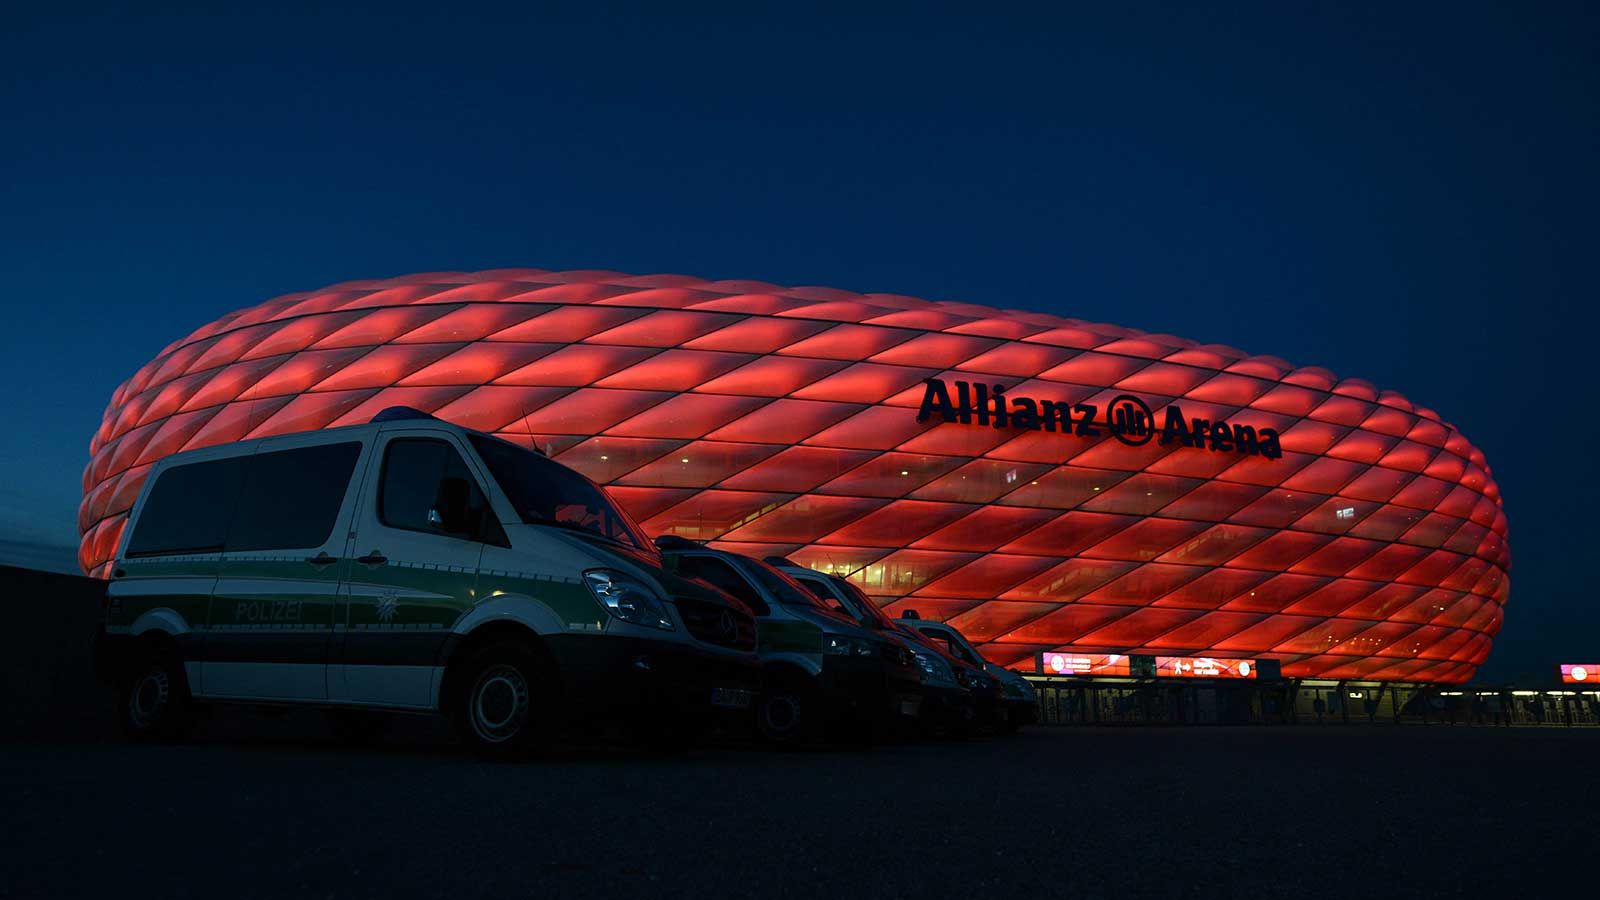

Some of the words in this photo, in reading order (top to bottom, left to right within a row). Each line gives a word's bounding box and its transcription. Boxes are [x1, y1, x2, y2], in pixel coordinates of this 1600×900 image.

[916, 378, 1100, 437] Allianz
[1158, 405, 1283, 459] Arena
[235, 600, 304, 622] POLIZEI
